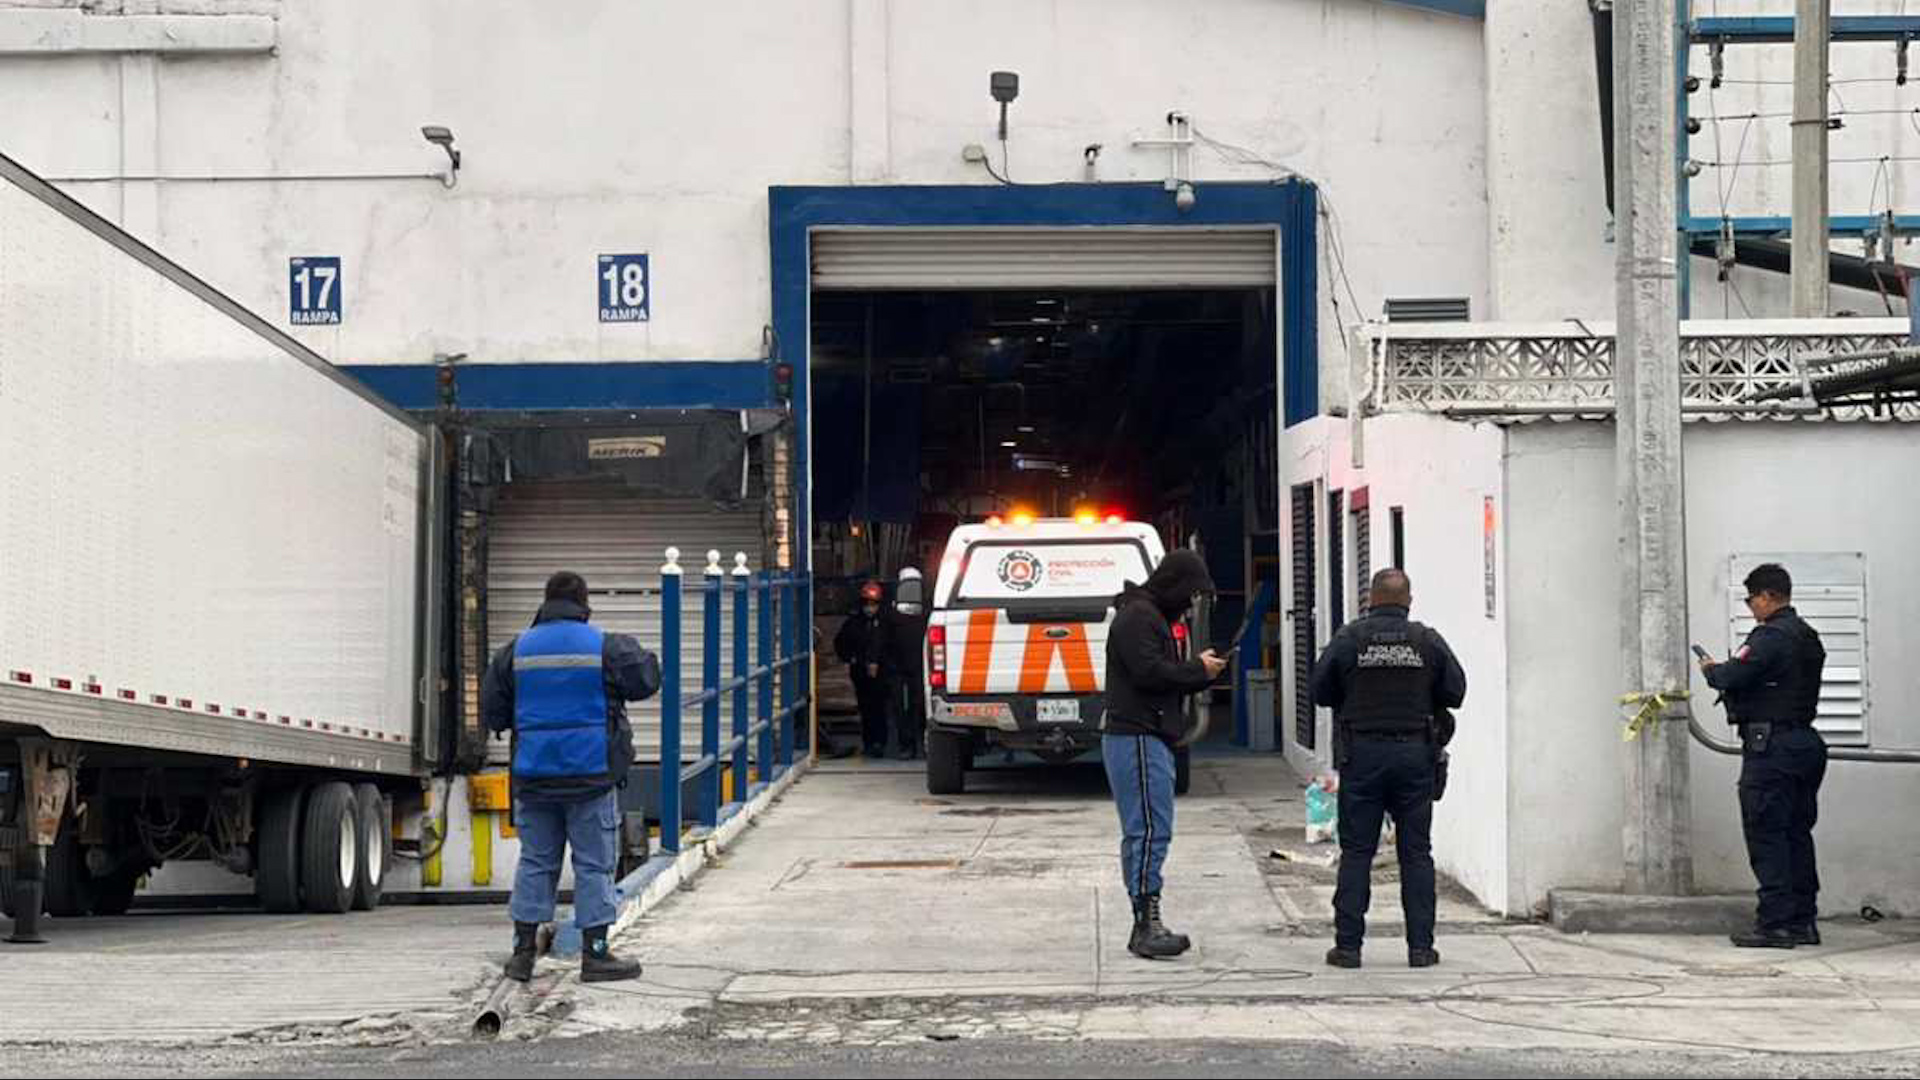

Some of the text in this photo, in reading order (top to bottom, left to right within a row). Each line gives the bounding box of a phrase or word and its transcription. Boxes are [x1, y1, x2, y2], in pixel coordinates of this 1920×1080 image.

[295, 267, 337, 309] 17
[603, 263, 645, 307] 18
[292, 311, 339, 323] RAMPA
[601, 308, 647, 320] RAMPA
